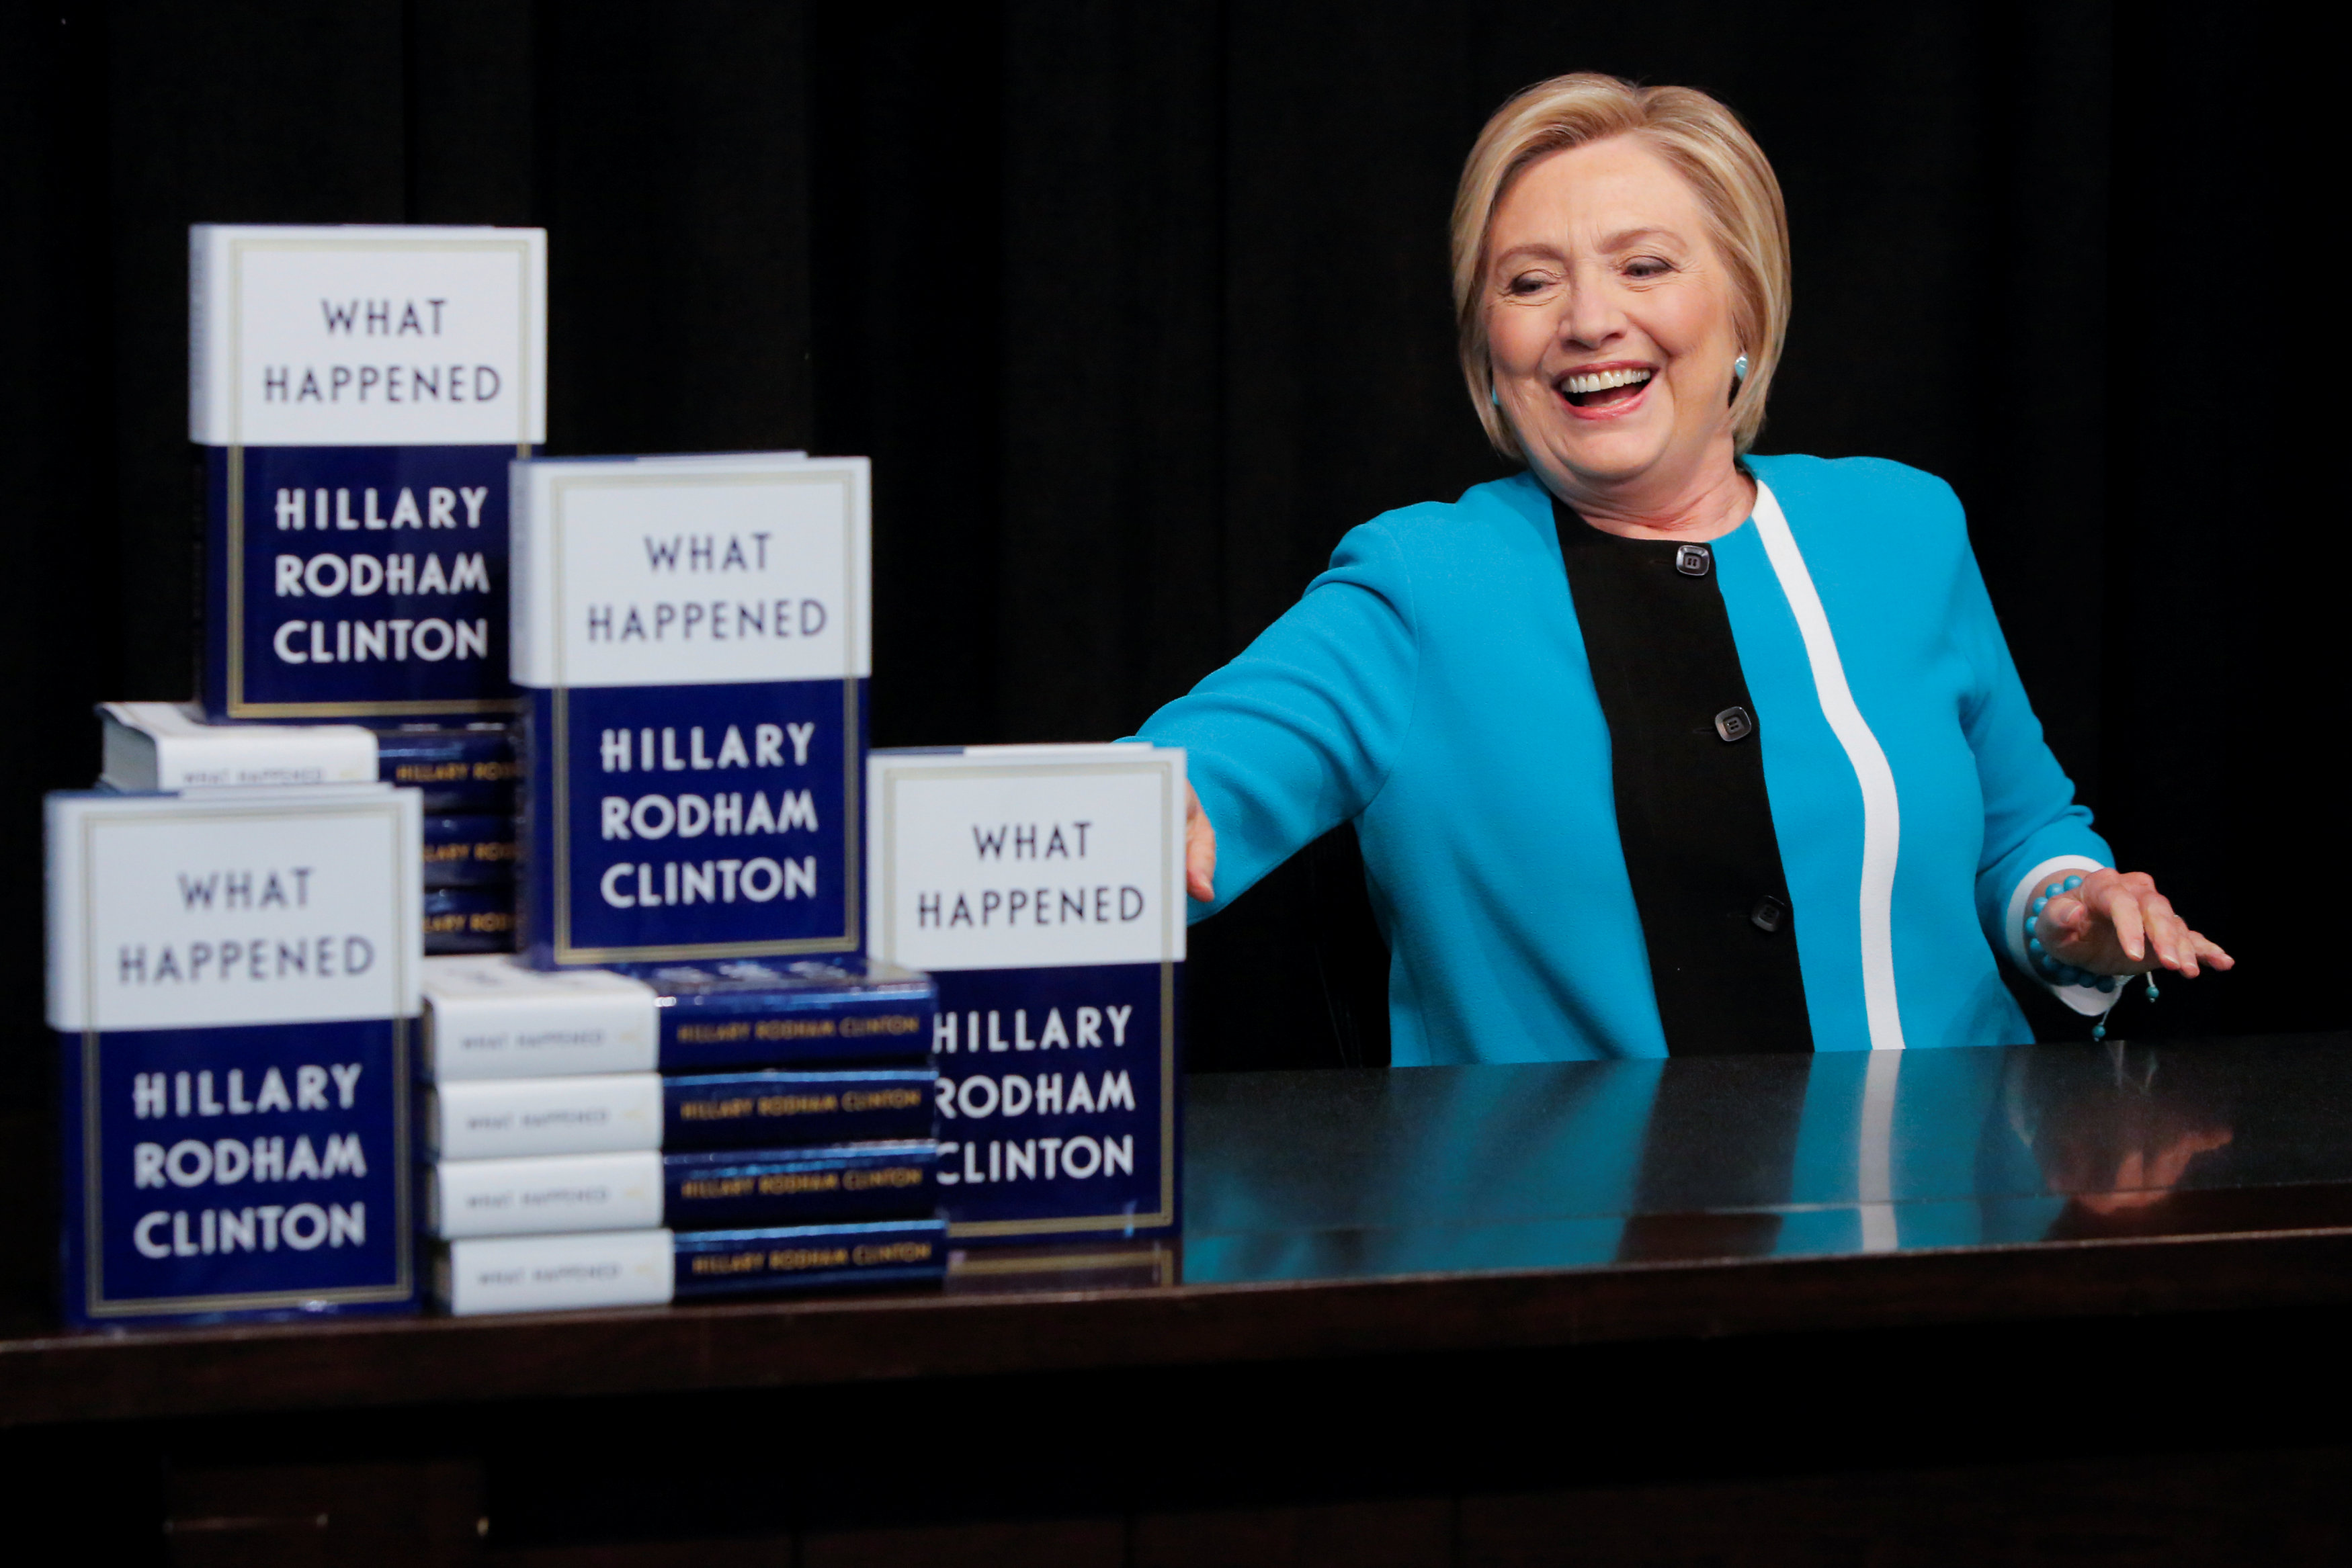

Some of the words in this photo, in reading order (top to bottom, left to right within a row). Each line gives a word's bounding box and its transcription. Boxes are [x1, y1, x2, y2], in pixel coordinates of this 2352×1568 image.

[322, 299, 446, 335] WHAT
[264, 365, 501, 403] HAPPENED
[275, 487, 487, 530] HILLARY
[644, 532, 770, 571] WHAT
[276, 554, 489, 597] RODHAM
[274, 618, 487, 664] CLINTON
[587, 599, 827, 642] HAPPENED
[600, 722, 814, 772] HILLARY
[601, 790, 818, 840] RODHAM
[973, 822, 1091, 859] WHAT
[178, 867, 311, 910] WHAT
[601, 856, 816, 908] CLINTON
[918, 885, 1144, 928] HAPPENED
[118, 935, 374, 984] HAPPENED
[932, 1005, 1132, 1053] HILLARY
[133, 1063, 361, 1118] HILLARY
[935, 1070, 1135, 1119] RODHAM
[134, 1134, 366, 1188] RODHAM
[134, 1202, 365, 1258] CLINTON
